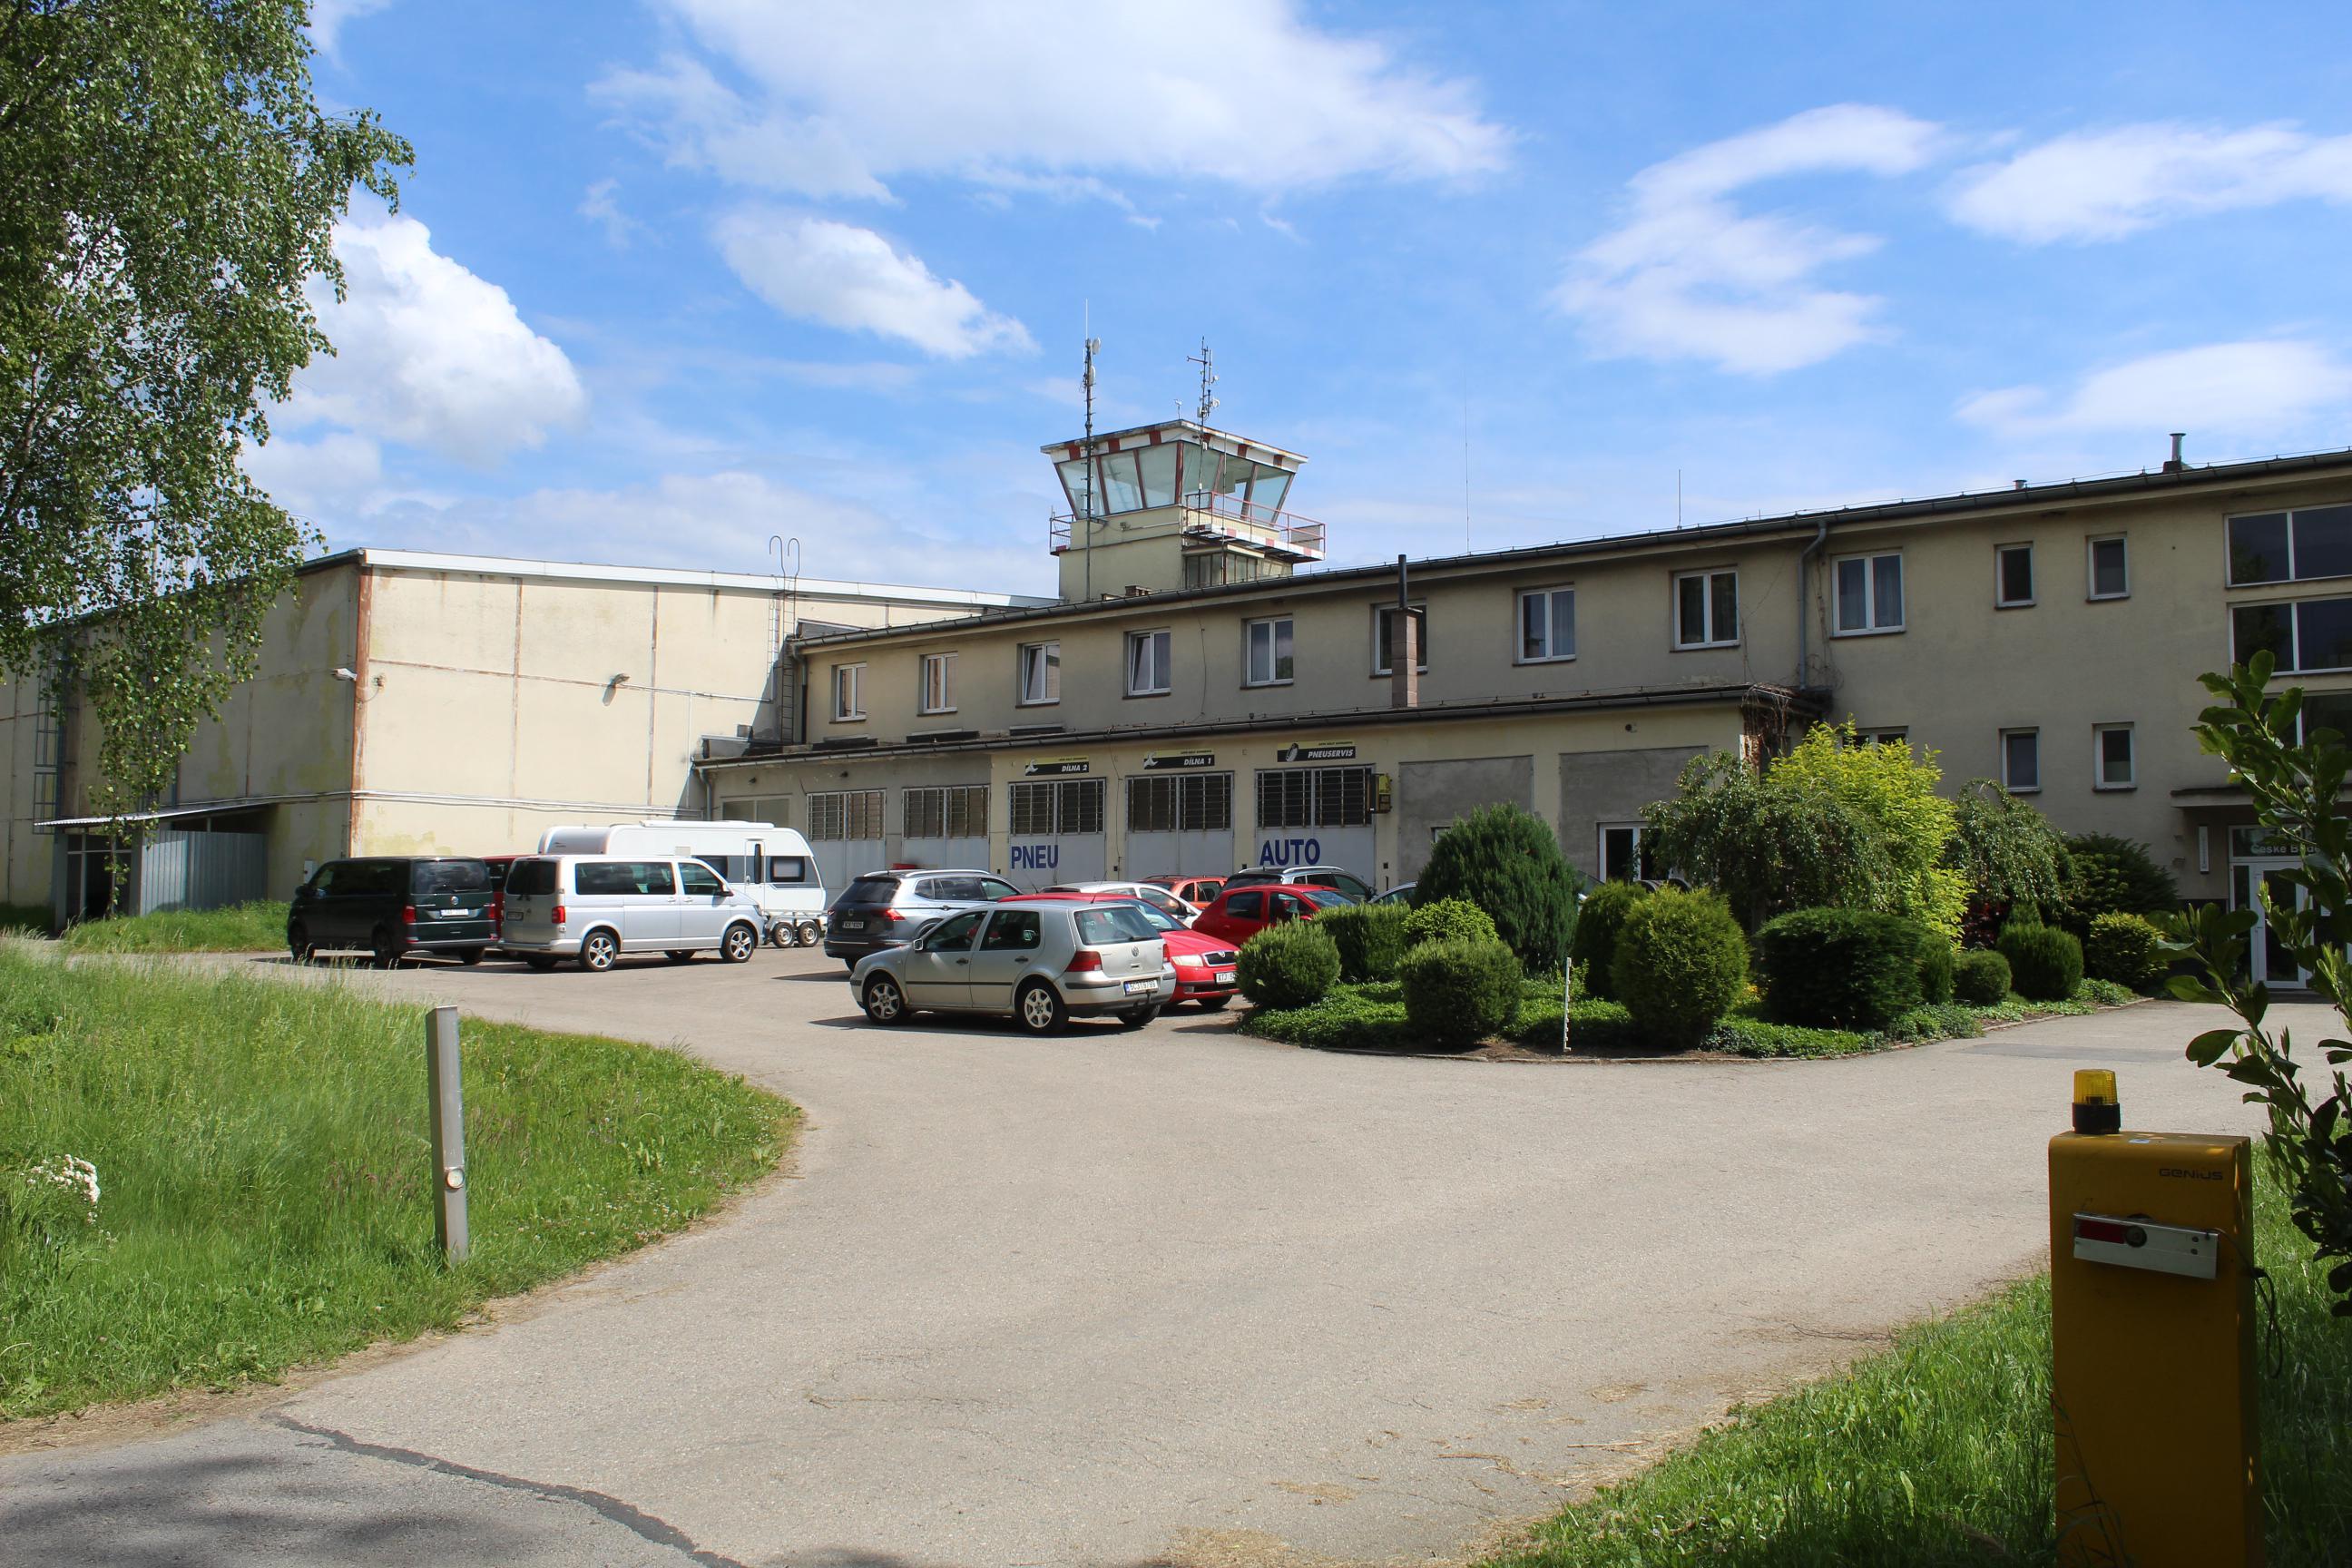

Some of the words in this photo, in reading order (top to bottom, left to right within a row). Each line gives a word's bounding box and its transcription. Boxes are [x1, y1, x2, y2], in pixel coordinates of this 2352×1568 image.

[1308, 749, 1354, 759] PNEUSERVIS
[1183, 757, 1205, 766] DÍLNA
[1061, 764, 1081, 772] DÍLNA
[1011, 845, 1059, 869] PNEU
[1259, 838, 1320, 866] AUTO
